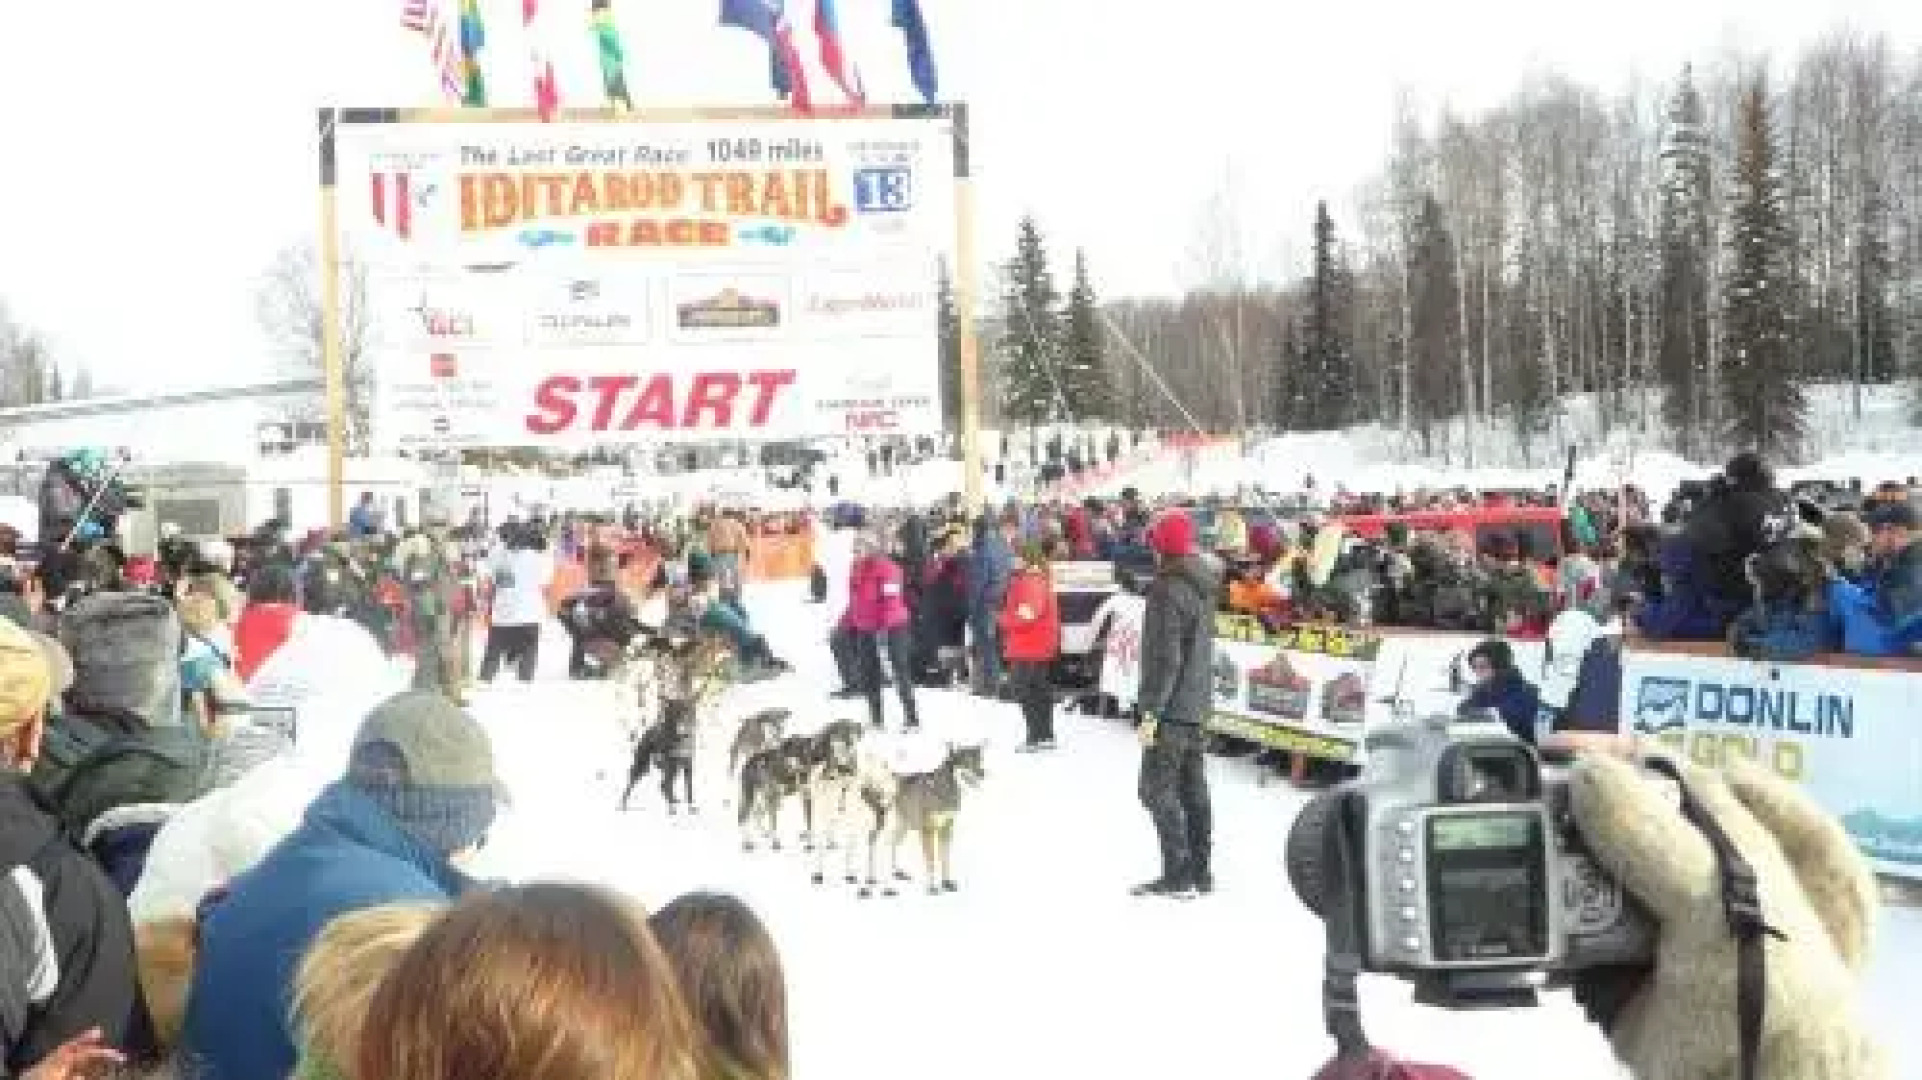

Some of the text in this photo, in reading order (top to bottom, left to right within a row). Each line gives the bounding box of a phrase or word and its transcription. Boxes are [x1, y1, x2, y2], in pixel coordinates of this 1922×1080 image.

[460, 145, 496, 166] The
[565, 145, 624, 168] Great
[634, 145, 692, 165] Race
[768, 138, 824, 162] miles
[459, 168, 848, 232] IDITAROD TRAIL
[585, 218, 729, 248] RACE
[525, 368, 796, 435] START
[1694, 683, 1853, 739] DONLIN
